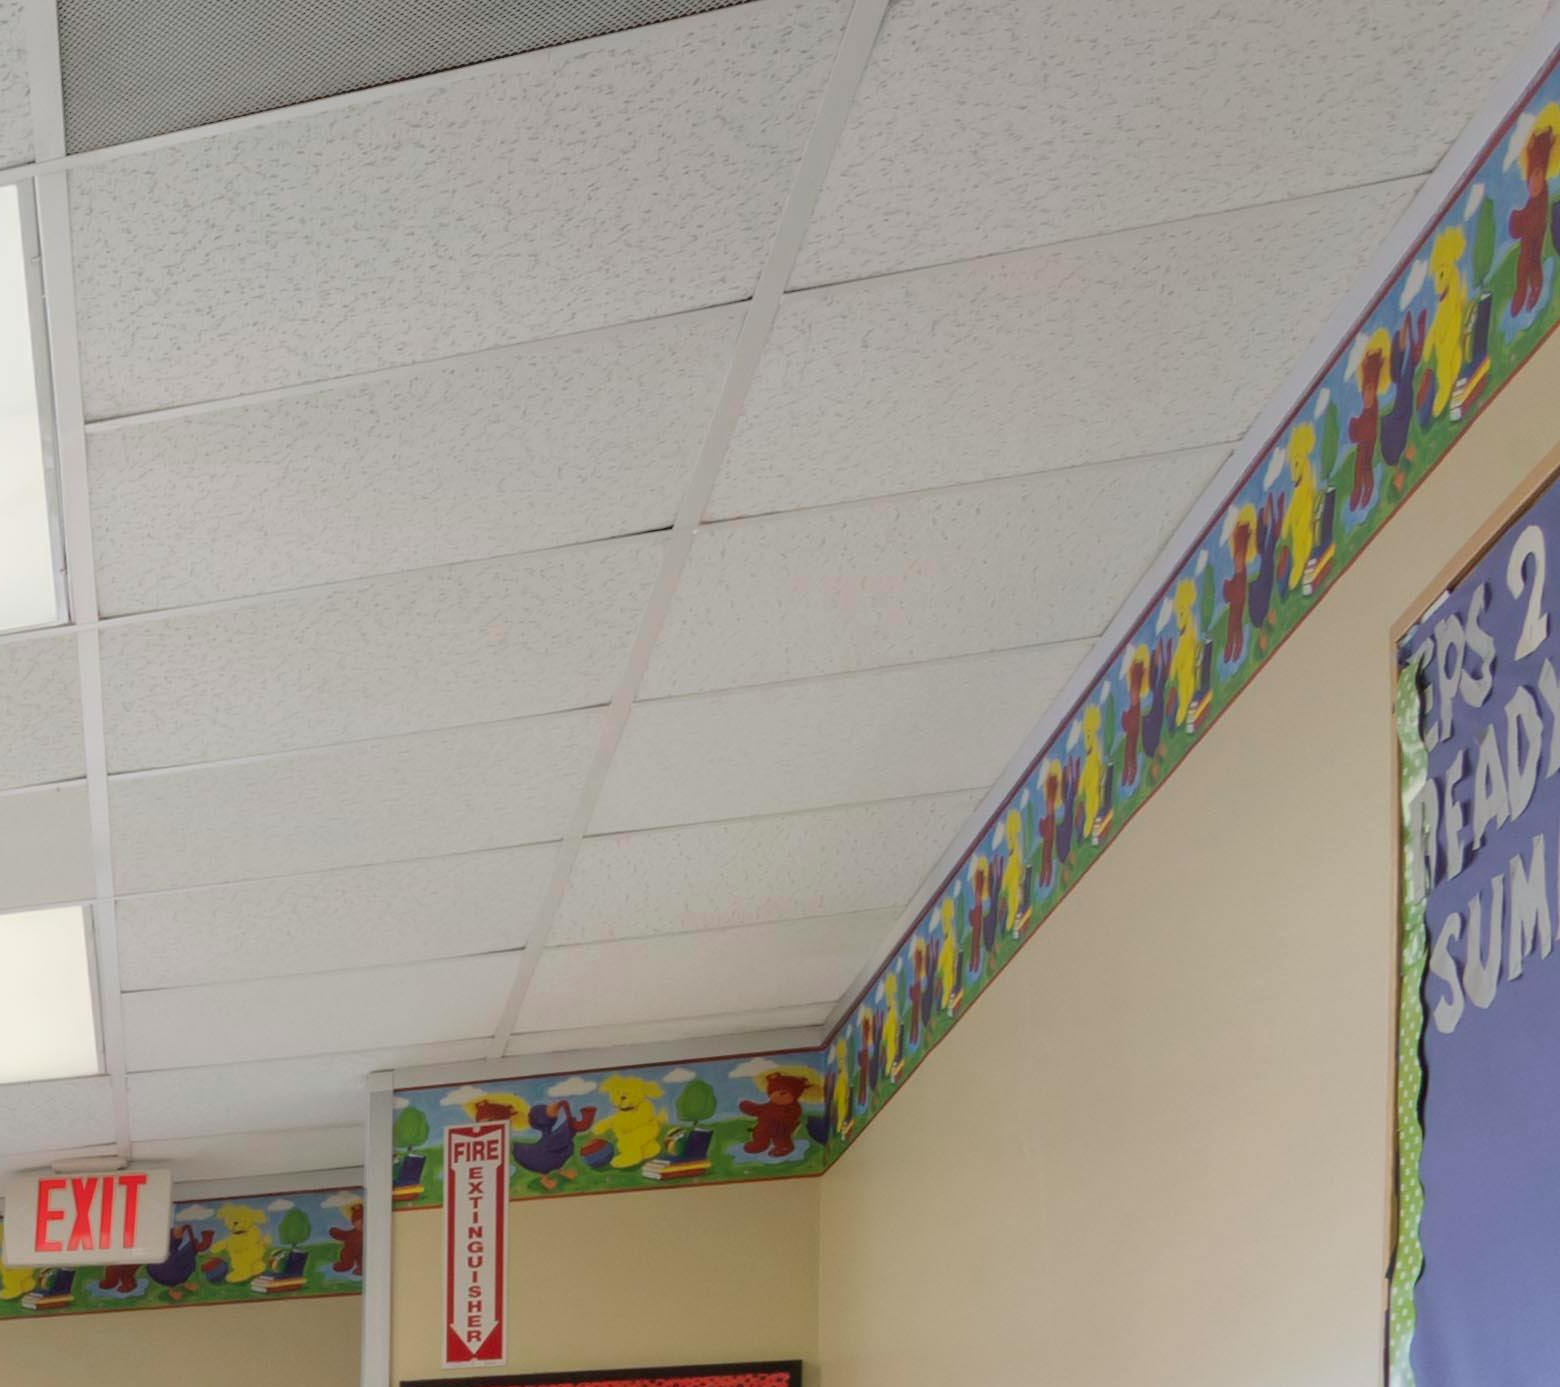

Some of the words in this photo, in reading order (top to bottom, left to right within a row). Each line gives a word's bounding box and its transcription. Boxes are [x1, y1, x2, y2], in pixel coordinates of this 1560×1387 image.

[1507, 526, 1548, 661] 2
[453, 1139, 499, 1163] FIRE
[34, 1173, 147, 1252] EXIT
[467, 1166, 484, 1343] EXTINGUISHER
